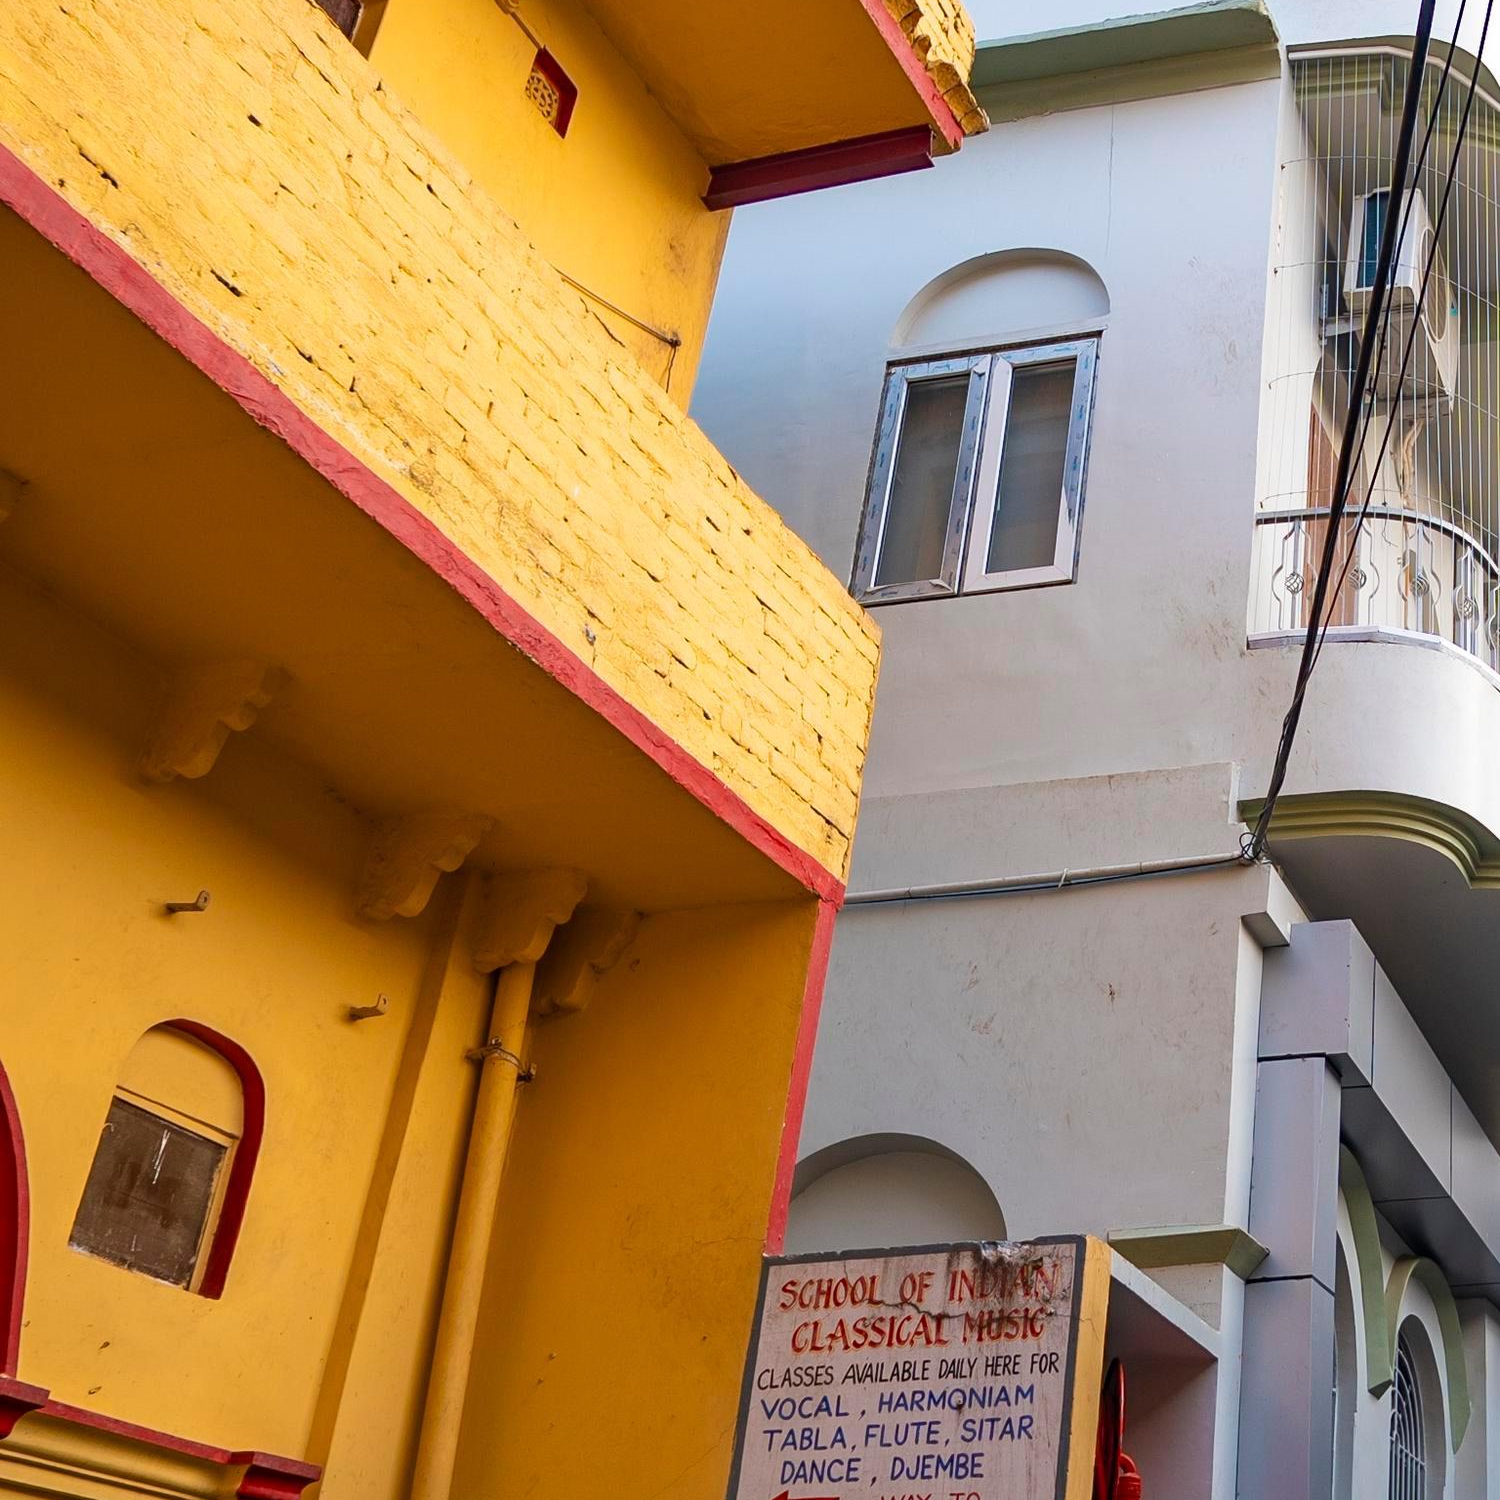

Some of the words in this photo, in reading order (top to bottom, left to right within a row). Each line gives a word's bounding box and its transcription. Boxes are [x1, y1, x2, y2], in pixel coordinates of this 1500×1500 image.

[779, 1275, 881, 1312] SCHOOL
[899, 1269, 934, 1305] OF
[791, 1313, 949, 1355] CLASSICAL
[962, 1308, 1046, 1344] MUSIC
[757, 1365, 834, 1390] CLASSES
[841, 1358, 930, 1384] AVAILABLE
[939, 1357, 978, 1379] DAILY
[984, 1354, 1021, 1377] HERE
[1030, 1352, 1060, 1374] FOR
[878, 1384, 1035, 1413] HARMONIAM
[961, 1415, 1034, 1442] SITAR
[890, 1452, 985, 1481] DJEMBE
